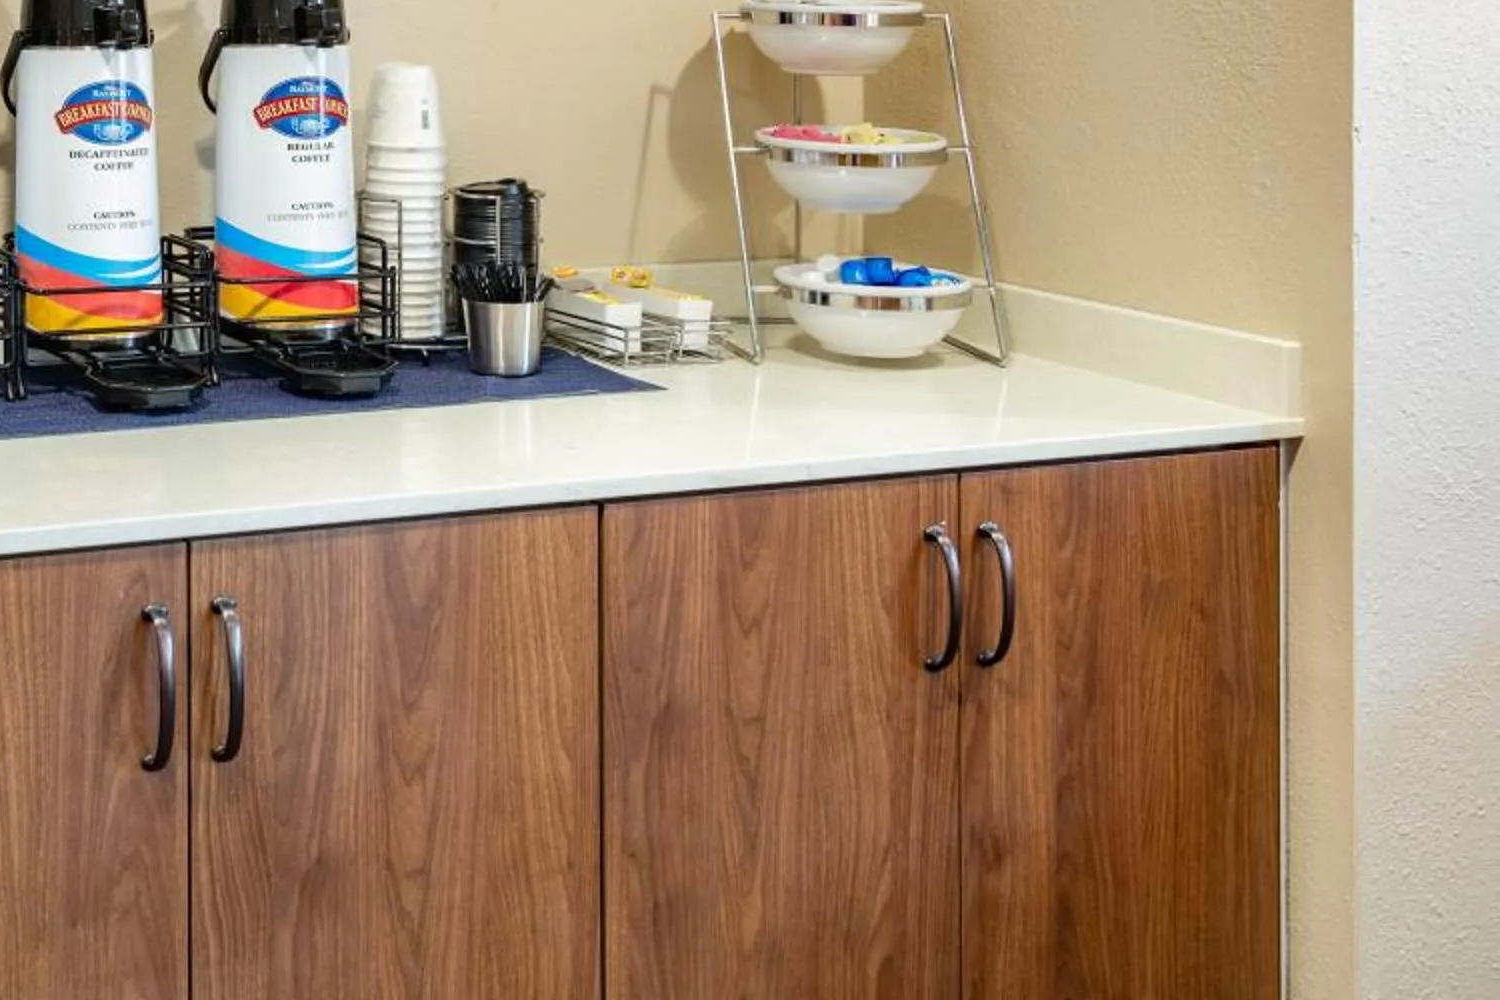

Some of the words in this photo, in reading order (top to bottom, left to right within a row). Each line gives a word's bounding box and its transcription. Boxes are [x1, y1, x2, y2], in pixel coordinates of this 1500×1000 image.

[256, 96, 318, 121] BREAKFAST
[58, 101, 118, 127] BREAKFAST
[287, 142, 335, 151] REGULAR
[291, 154, 331, 163] COFFEE
[93, 162, 134, 171] COFFEE
